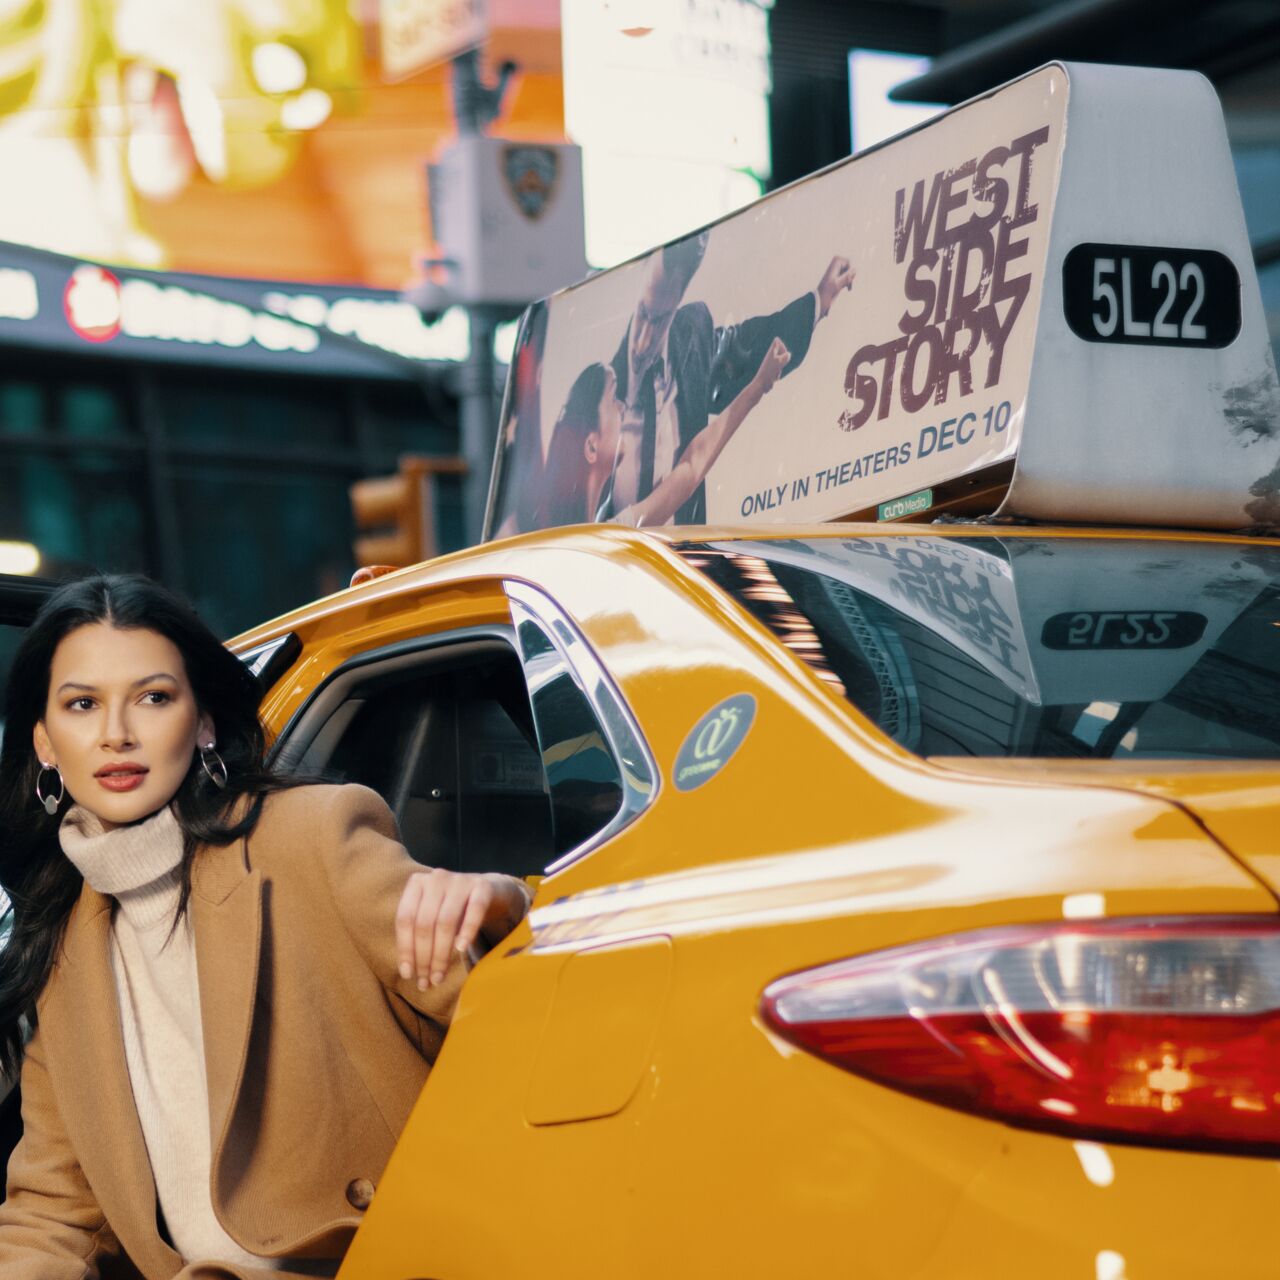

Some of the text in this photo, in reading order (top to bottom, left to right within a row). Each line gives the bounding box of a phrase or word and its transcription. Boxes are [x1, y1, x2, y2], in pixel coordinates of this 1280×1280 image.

[892, 125, 1050, 265] WEST
[898, 215, 1033, 335] SIDE
[1091, 256, 1208, 340] 5L22
[837, 277, 1032, 432] STORY
[740, 400, 1012, 517] ONLY IN THEATERS DEC 10
[883, 496, 927, 519] curb Media
